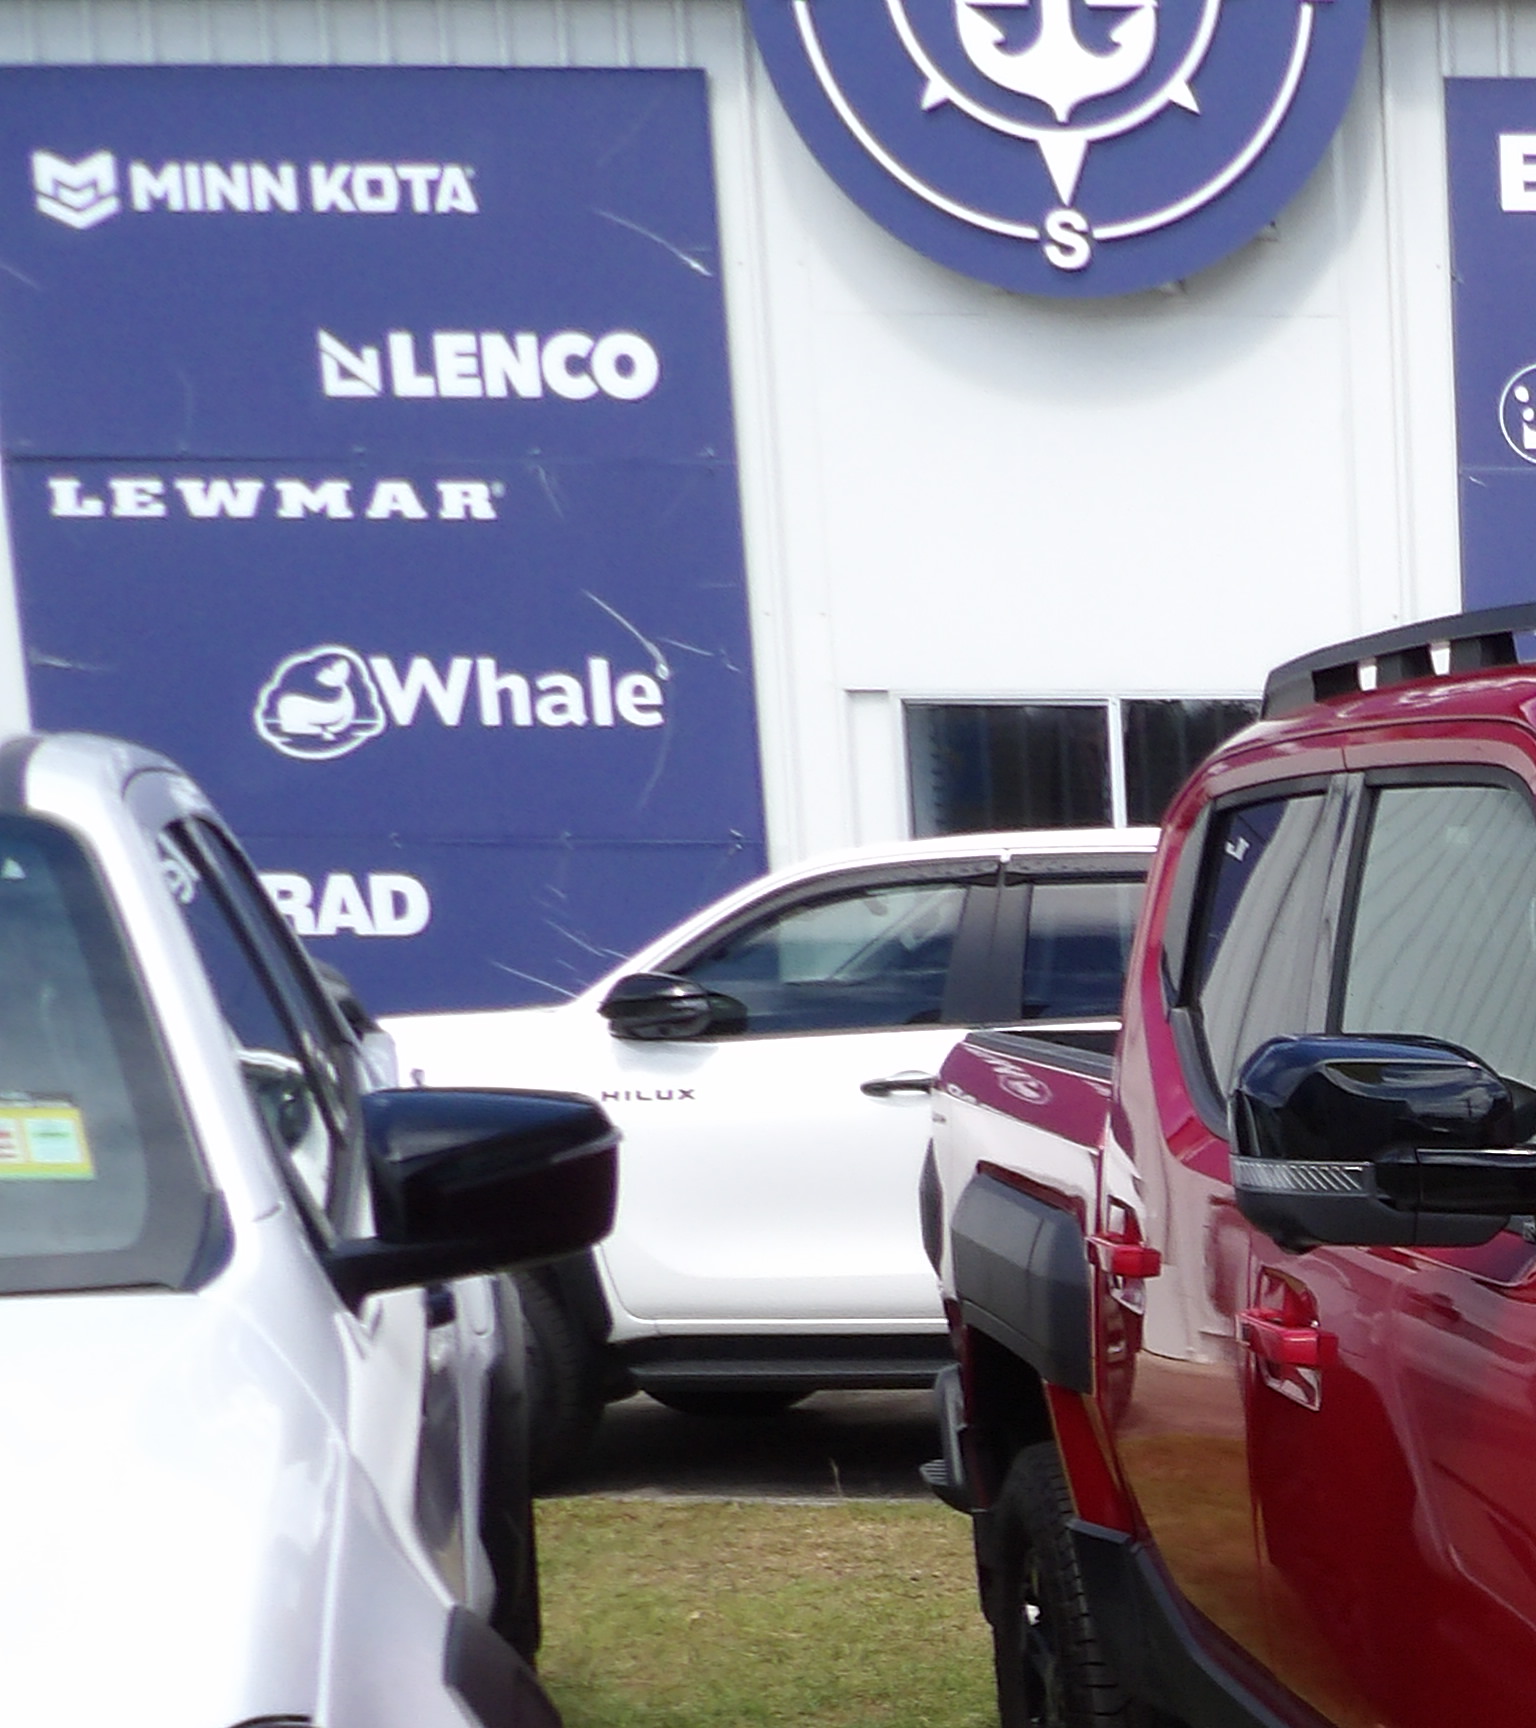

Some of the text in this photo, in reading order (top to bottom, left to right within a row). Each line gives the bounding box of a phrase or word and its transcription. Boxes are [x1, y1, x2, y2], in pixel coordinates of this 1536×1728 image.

[129, 163, 479, 214] MINN KOTA
[1043, 208, 1093, 270] S
[387, 331, 659, 400] LENCO
[48, 478, 499, 520] LEWMAR
[372, 656, 665, 727] Whale
[602, 1088, 696, 1101] HILUX
